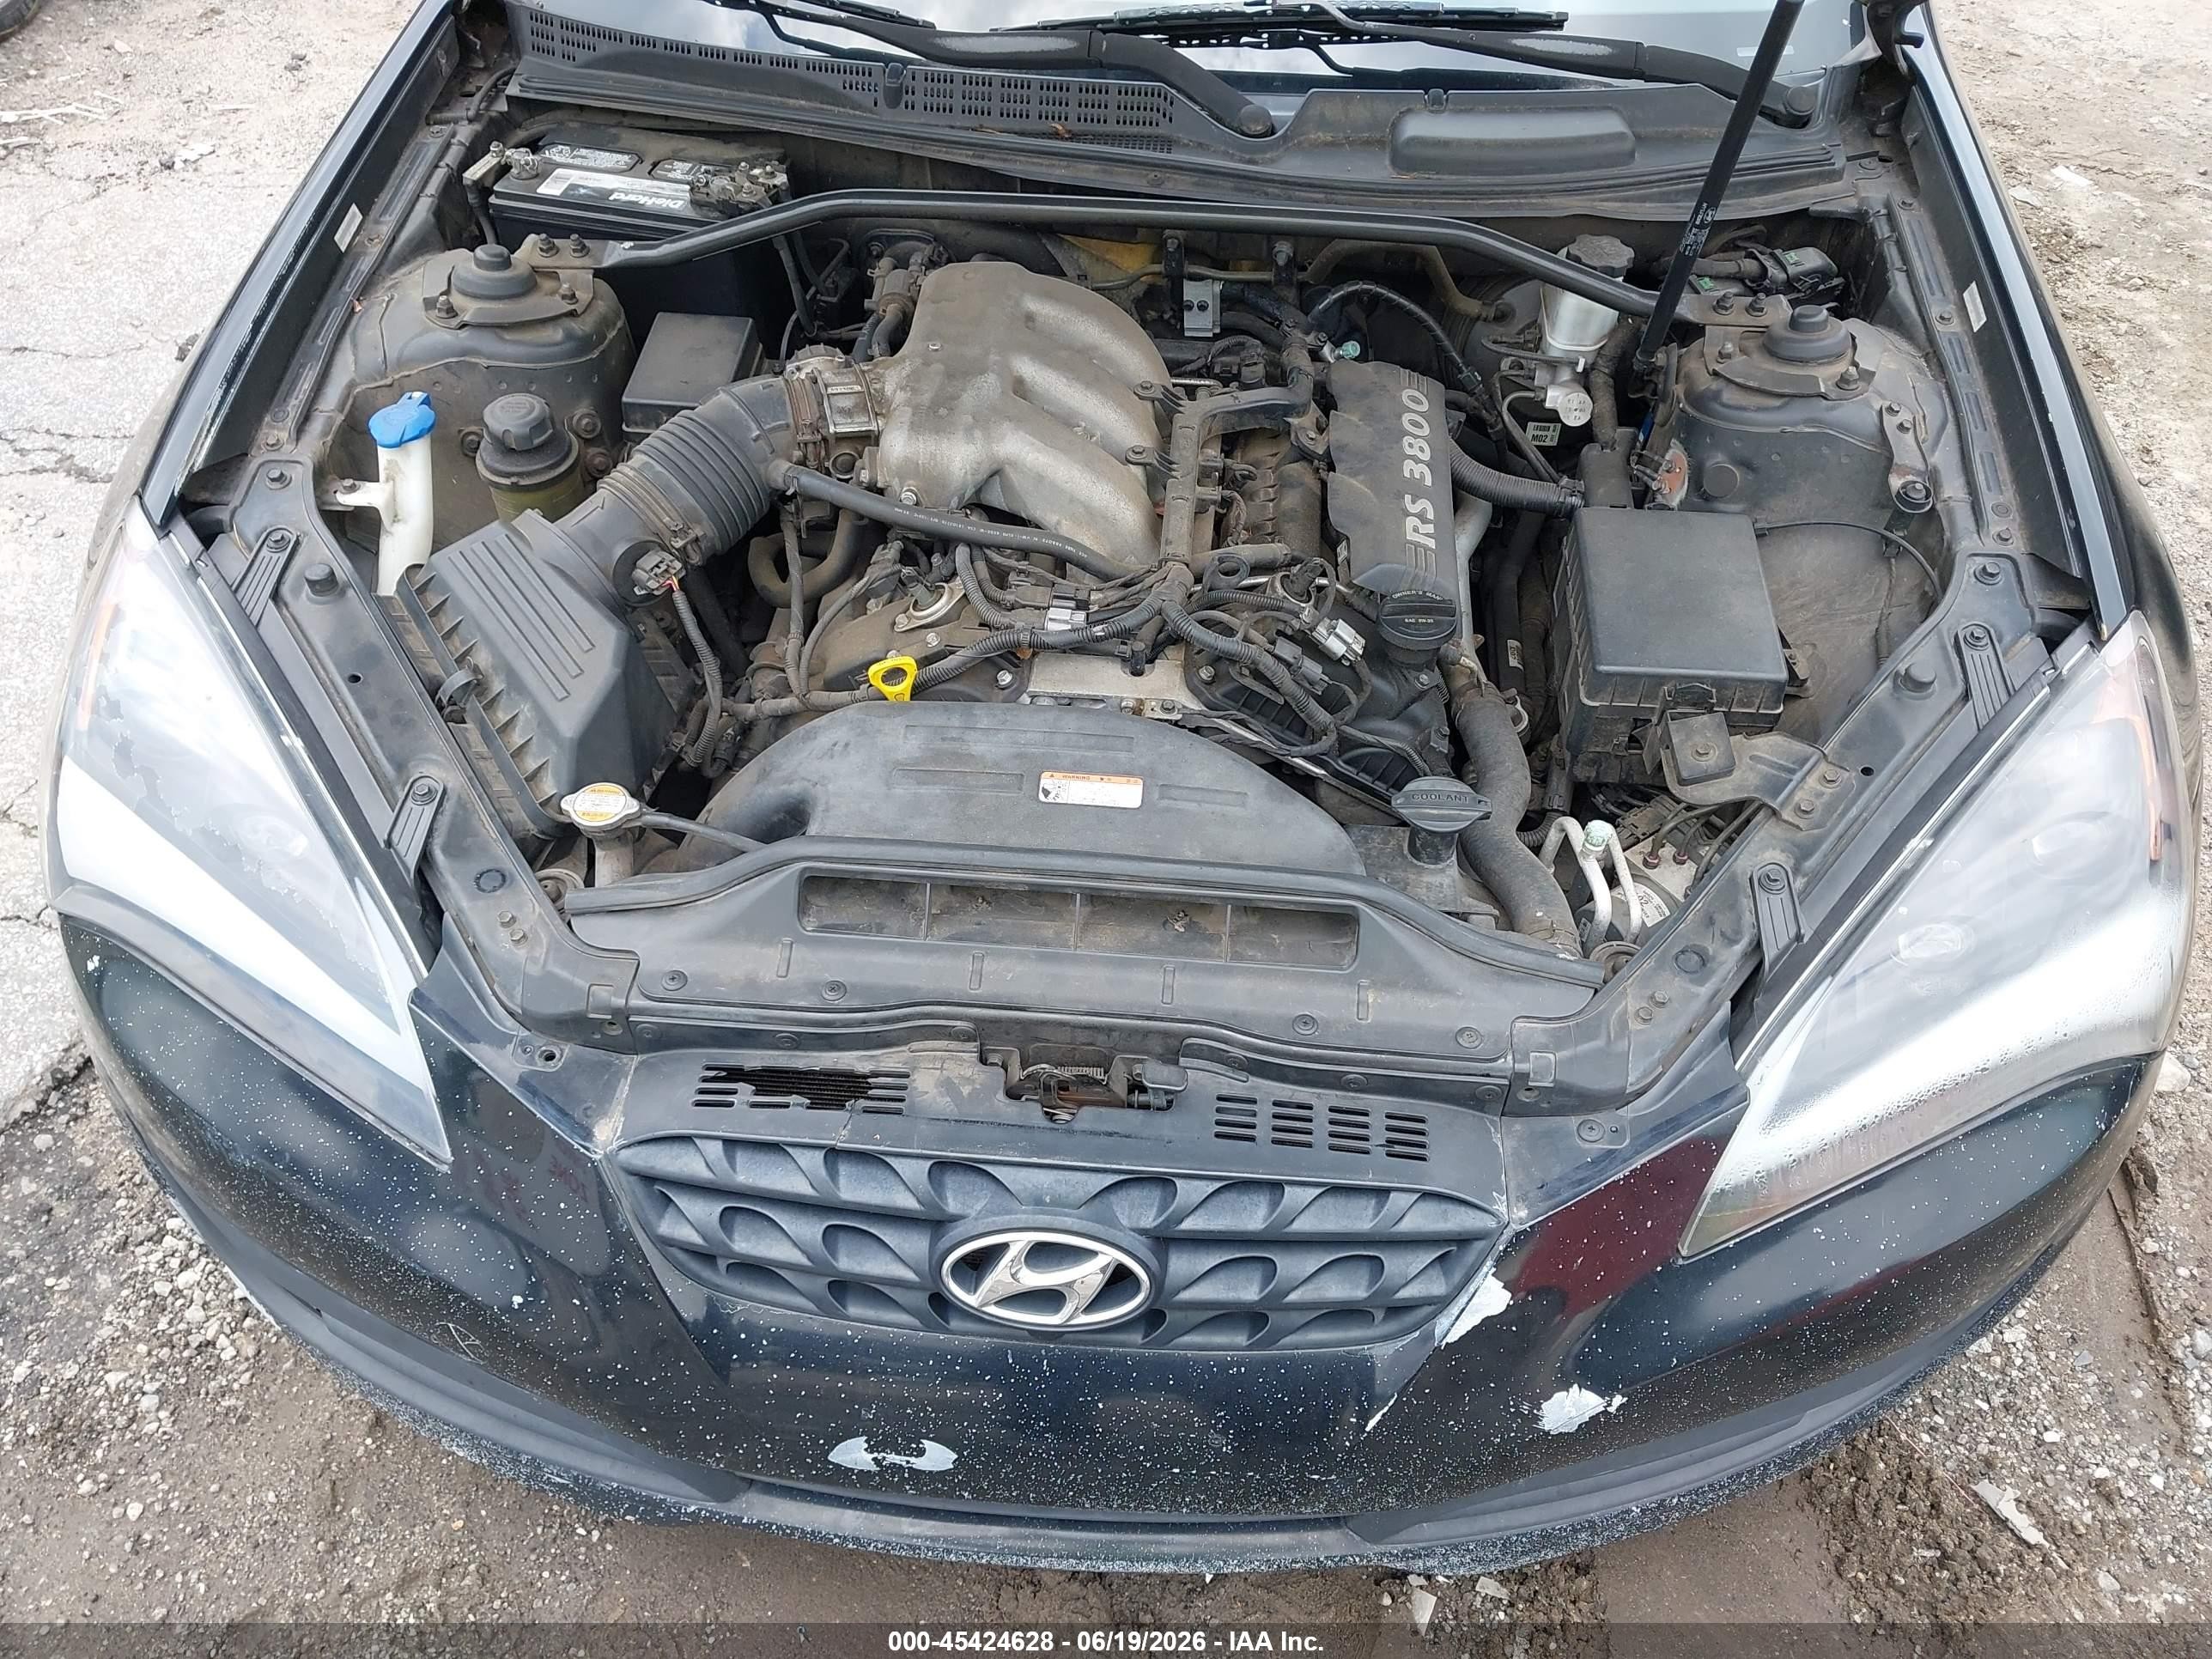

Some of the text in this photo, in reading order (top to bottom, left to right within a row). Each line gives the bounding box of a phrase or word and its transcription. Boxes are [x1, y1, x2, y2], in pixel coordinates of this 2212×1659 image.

[608, 191, 685, 208] DieHard
[1531, 434, 1548, 442] M02
[1401, 388, 1436, 550] RS 3800
[1412, 793, 1469, 804] COOLANT
